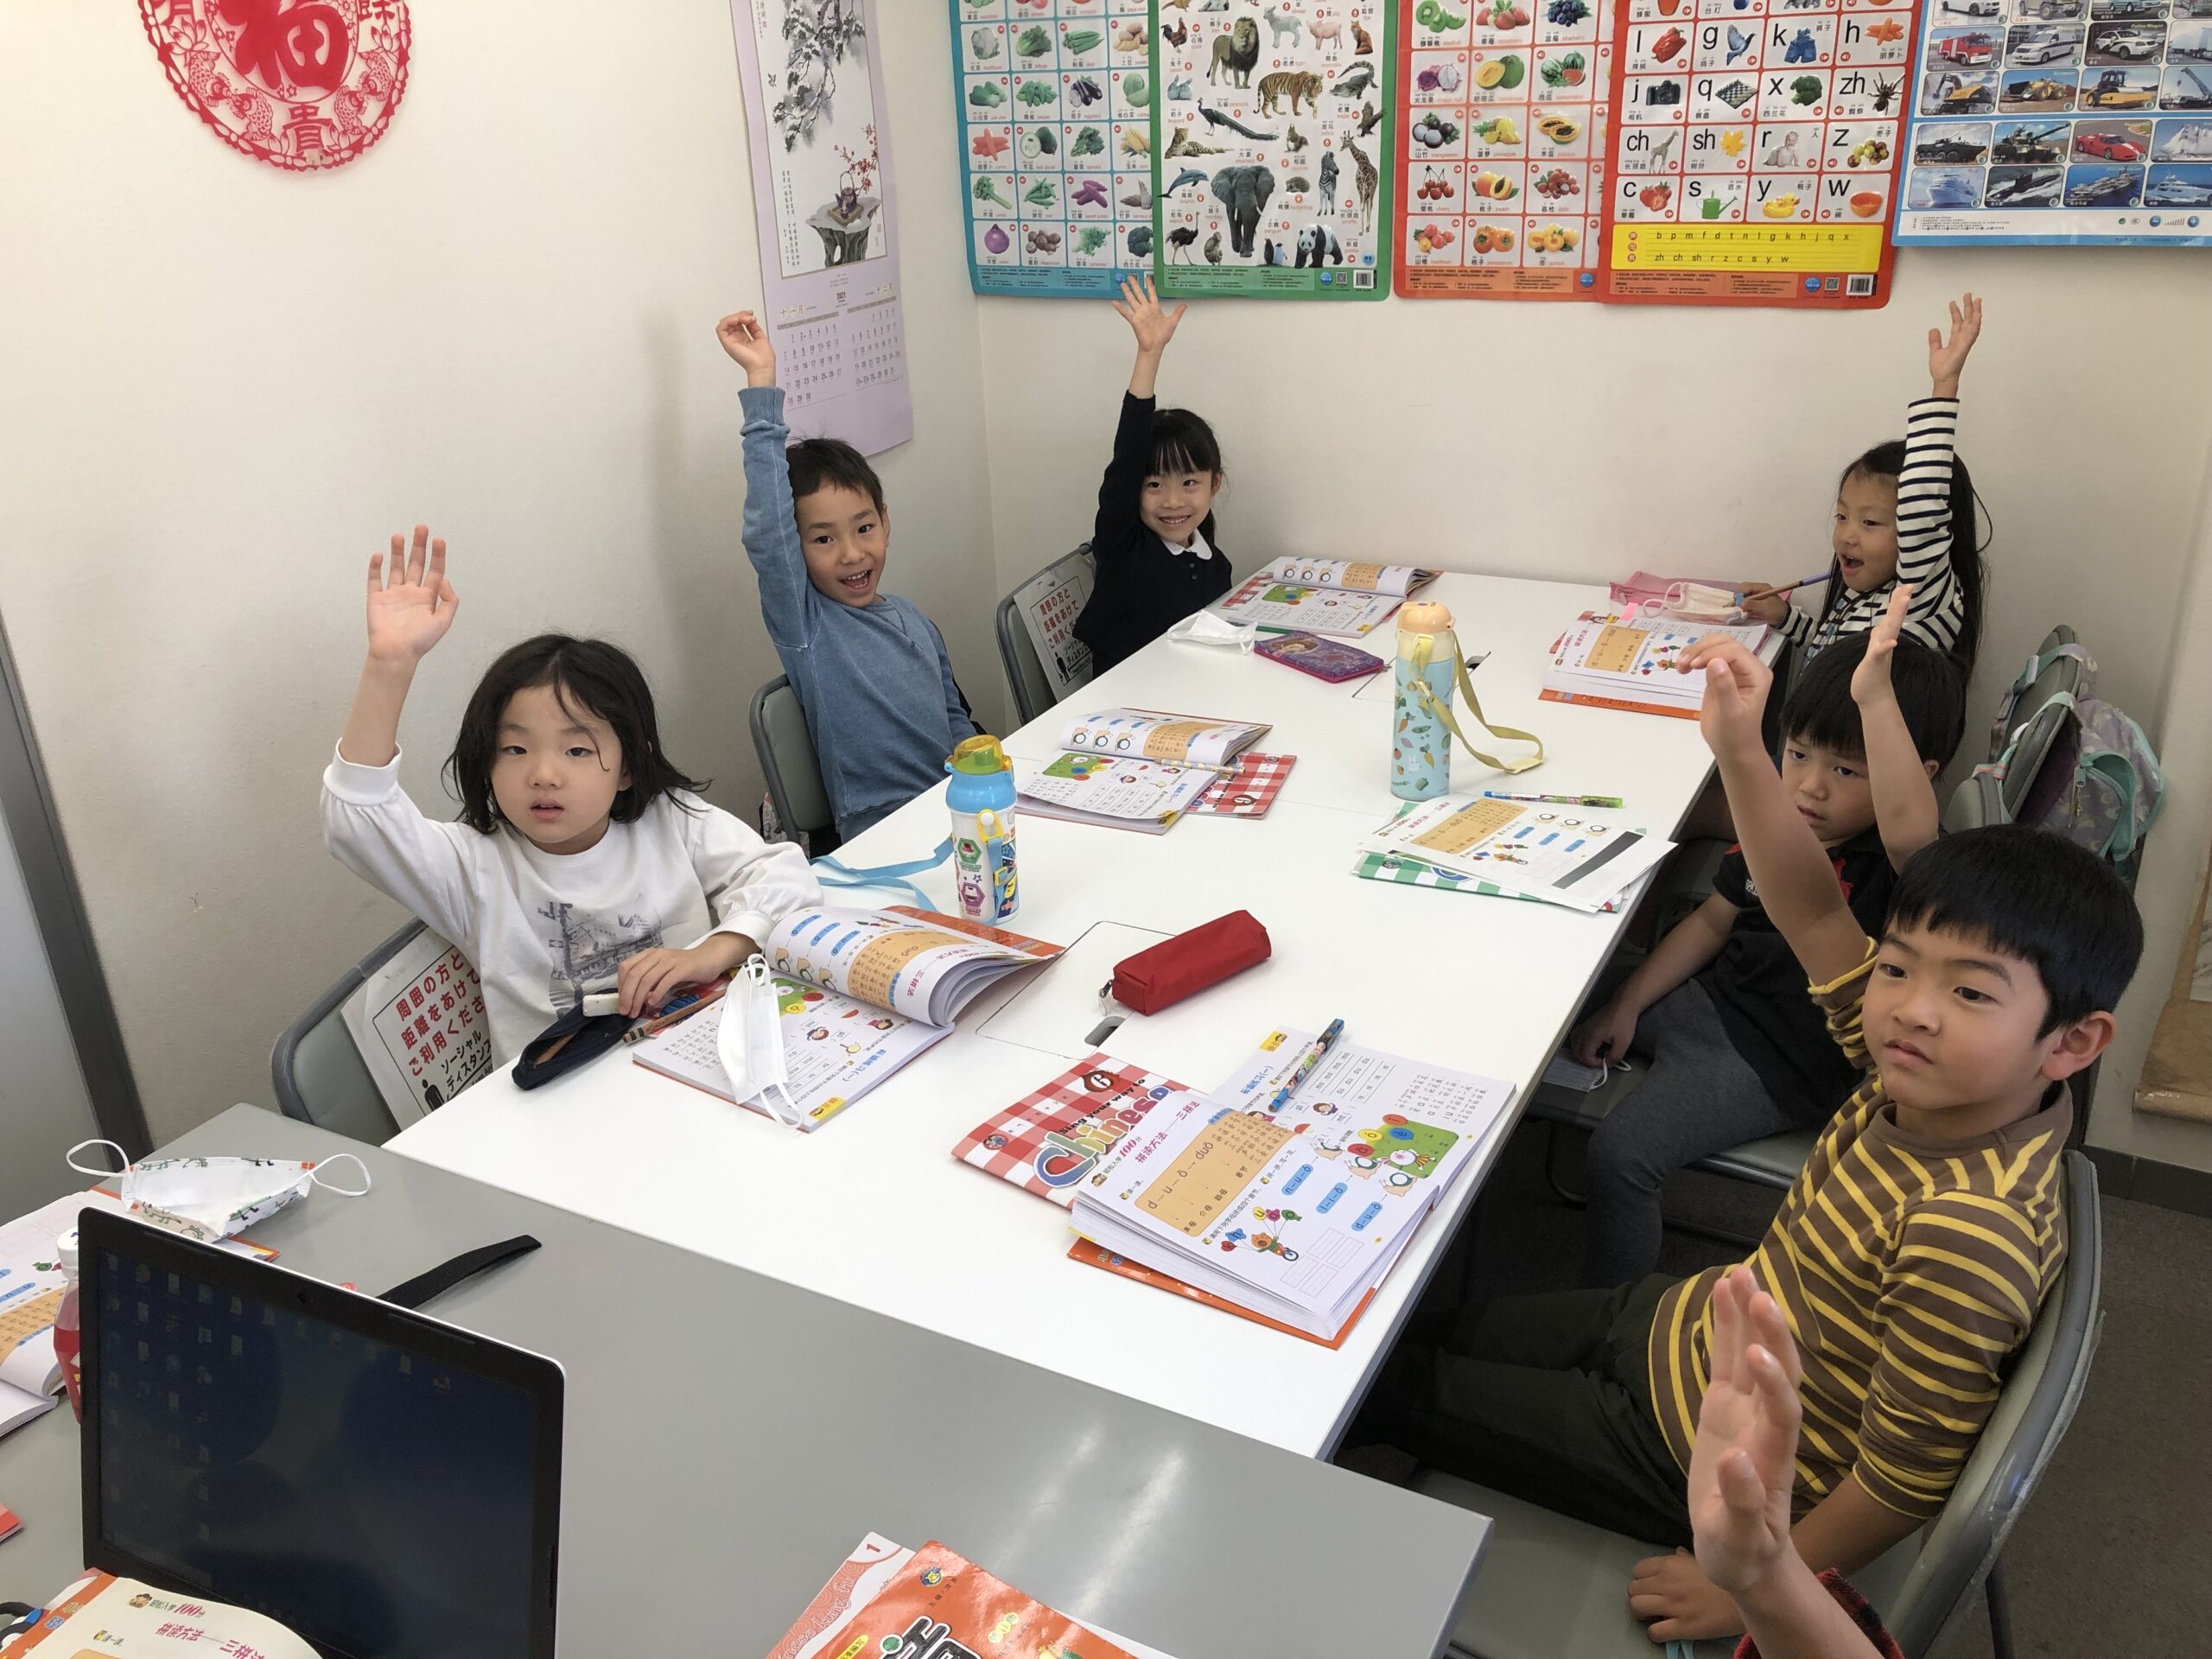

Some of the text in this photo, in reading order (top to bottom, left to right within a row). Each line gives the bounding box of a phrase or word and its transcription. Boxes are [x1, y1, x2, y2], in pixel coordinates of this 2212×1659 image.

[1703, 27, 1718, 48] g
[1773, 24, 1787, 46] k
[1846, 21, 1859, 42] h
[1632, 80, 1639, 102] j
[1699, 79, 1712, 100] q
[1770, 78, 1783, 94] x
[1839, 72, 1865, 94] zh
[1627, 130, 1649, 151] ch
[1693, 129, 1715, 149] sh
[1762, 130, 1770, 148] r
[1833, 129, 1848, 146] z
[1624, 181, 1637, 197] c
[1689, 181, 1701, 196] s
[1757, 181, 1771, 201] y
[1828, 180, 1851, 196] w
[781, 305, 804, 318] 十一月
[396, 953, 464, 1021] 周囲の方と
[401, 968, 480, 1050] 距離をあけて
[441, 1030, 481, 1074] ソーシャル
[447, 1039, 491, 1092] ディスタンス
[1091, 1075, 1111, 1086] 6
[1058, 1078, 1145, 1135] Sing your way to
[1148, 1200, 1158, 1209] d
[1196, 1141, 1214, 1160] duō
[866, 1543, 880, 1553] 1
[781, 1577, 855, 1659] nese kung fu
